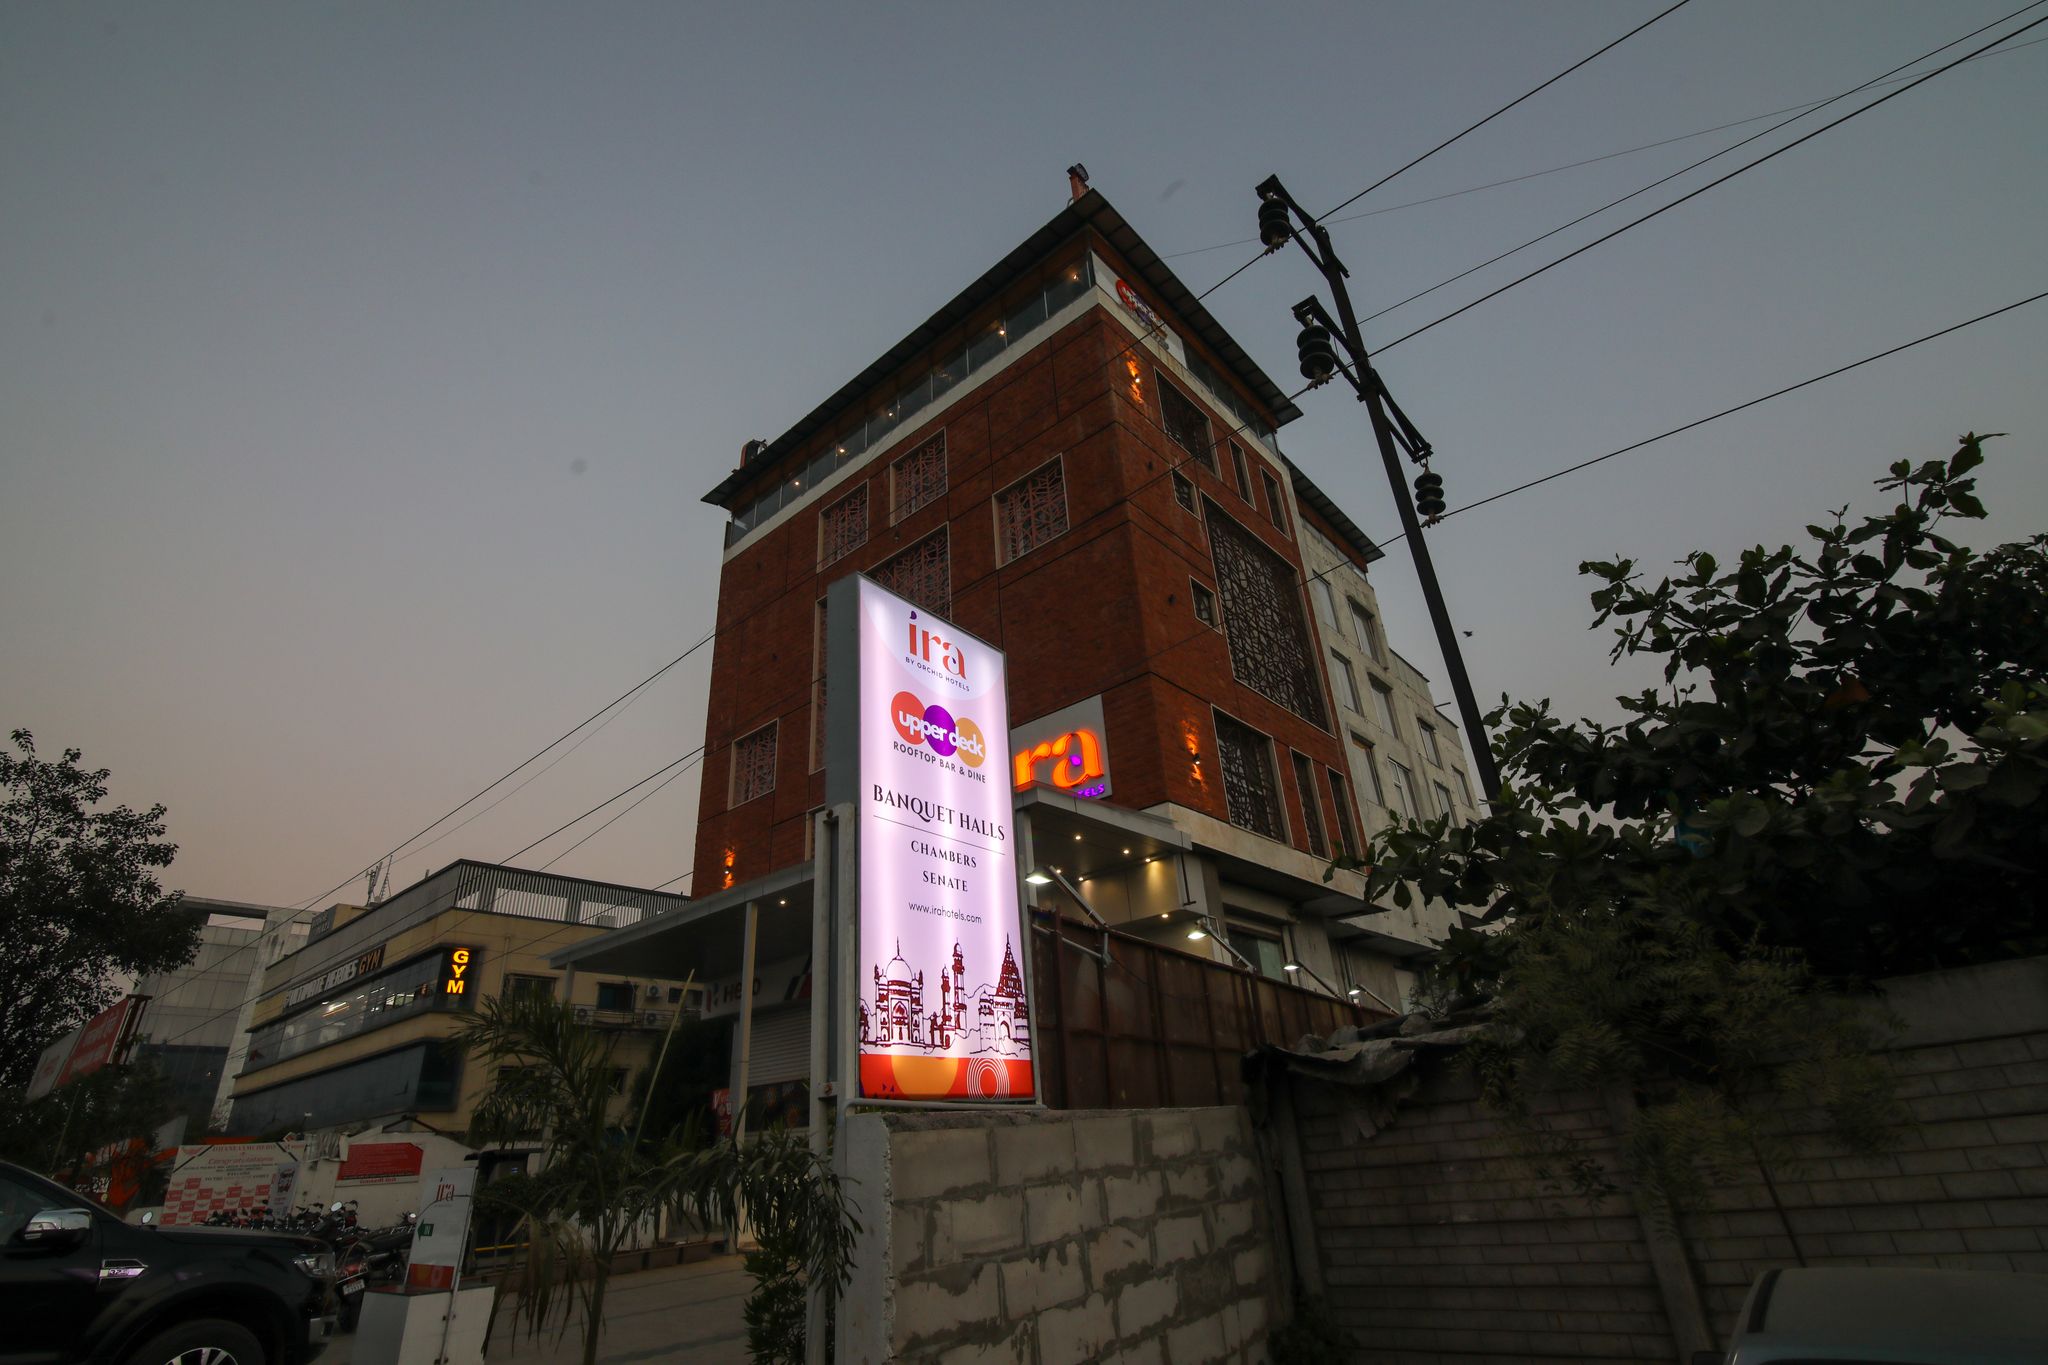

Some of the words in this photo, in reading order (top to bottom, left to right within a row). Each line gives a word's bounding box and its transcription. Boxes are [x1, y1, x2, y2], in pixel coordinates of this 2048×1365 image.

[908, 610, 967, 680] ira
[905, 656, 915, 668] BY
[917, 662, 944, 679] ORCHID
[945, 676, 970, 692] HOTELS
[899, 710, 948, 741] upper
[949, 726, 984, 758] deck
[893, 740, 936, 764] ROOFTOP
[939, 757, 956, 773] BAR
[958, 765, 966, 776] &
[967, 766, 986, 784] DINE
[873, 784, 955, 824] BANQUET
[959, 812, 1005, 841] HALLS
[911, 840, 977, 868] CHAMBERS
[922, 870, 968, 892] SENATE
[908, 902, 982, 924] www.irahotels.com
[447, 950, 469, 994] GYM
[723, 977, 761, 1003] Heo
